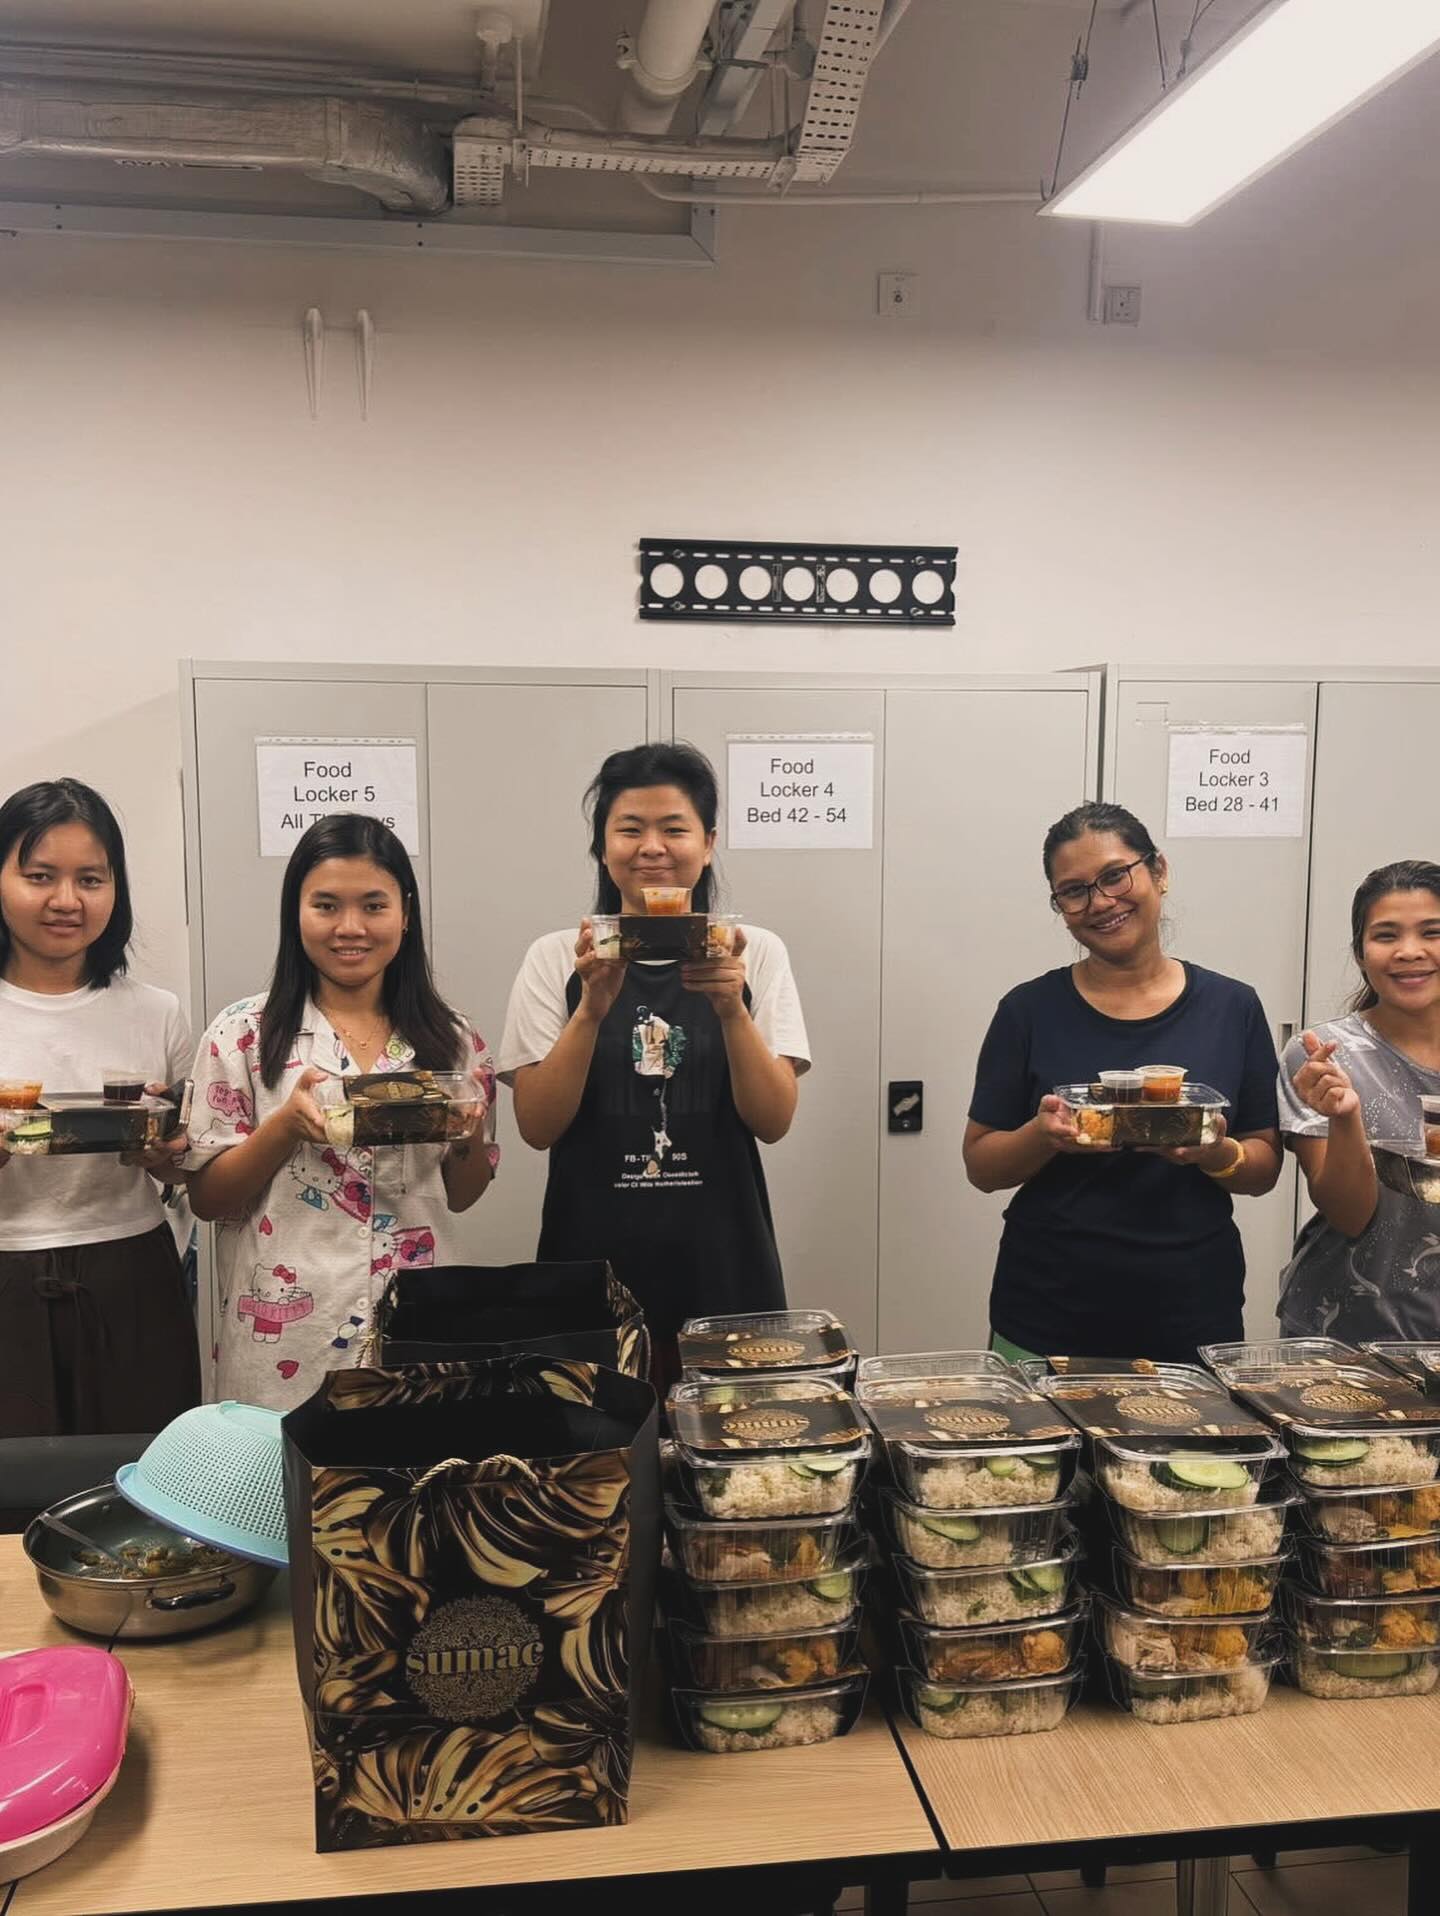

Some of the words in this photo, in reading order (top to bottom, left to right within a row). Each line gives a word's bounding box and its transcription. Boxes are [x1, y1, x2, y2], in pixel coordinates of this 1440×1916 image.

[1209, 748, 1250, 764] Food
[304, 761, 352, 778] Food
[770, 758, 814, 774] Food
[1199, 771, 1254, 787] Locker
[1259, 771, 1269, 787] 3
[294, 786, 358, 802] Locker
[364, 786, 375, 802] 5
[760, 782, 819, 798] Locker
[823, 782, 834, 797] 4
[1185, 796, 1218, 812] Bed
[1223, 796, 1243, 812] 28
[1259, 796, 1278, 812] 41
[280, 813, 303, 829] All
[747, 807, 781, 823] Bed
[787, 807, 809, 823] 42
[826, 807, 846, 823] 54
[405, 1641, 545, 1676] sumac
